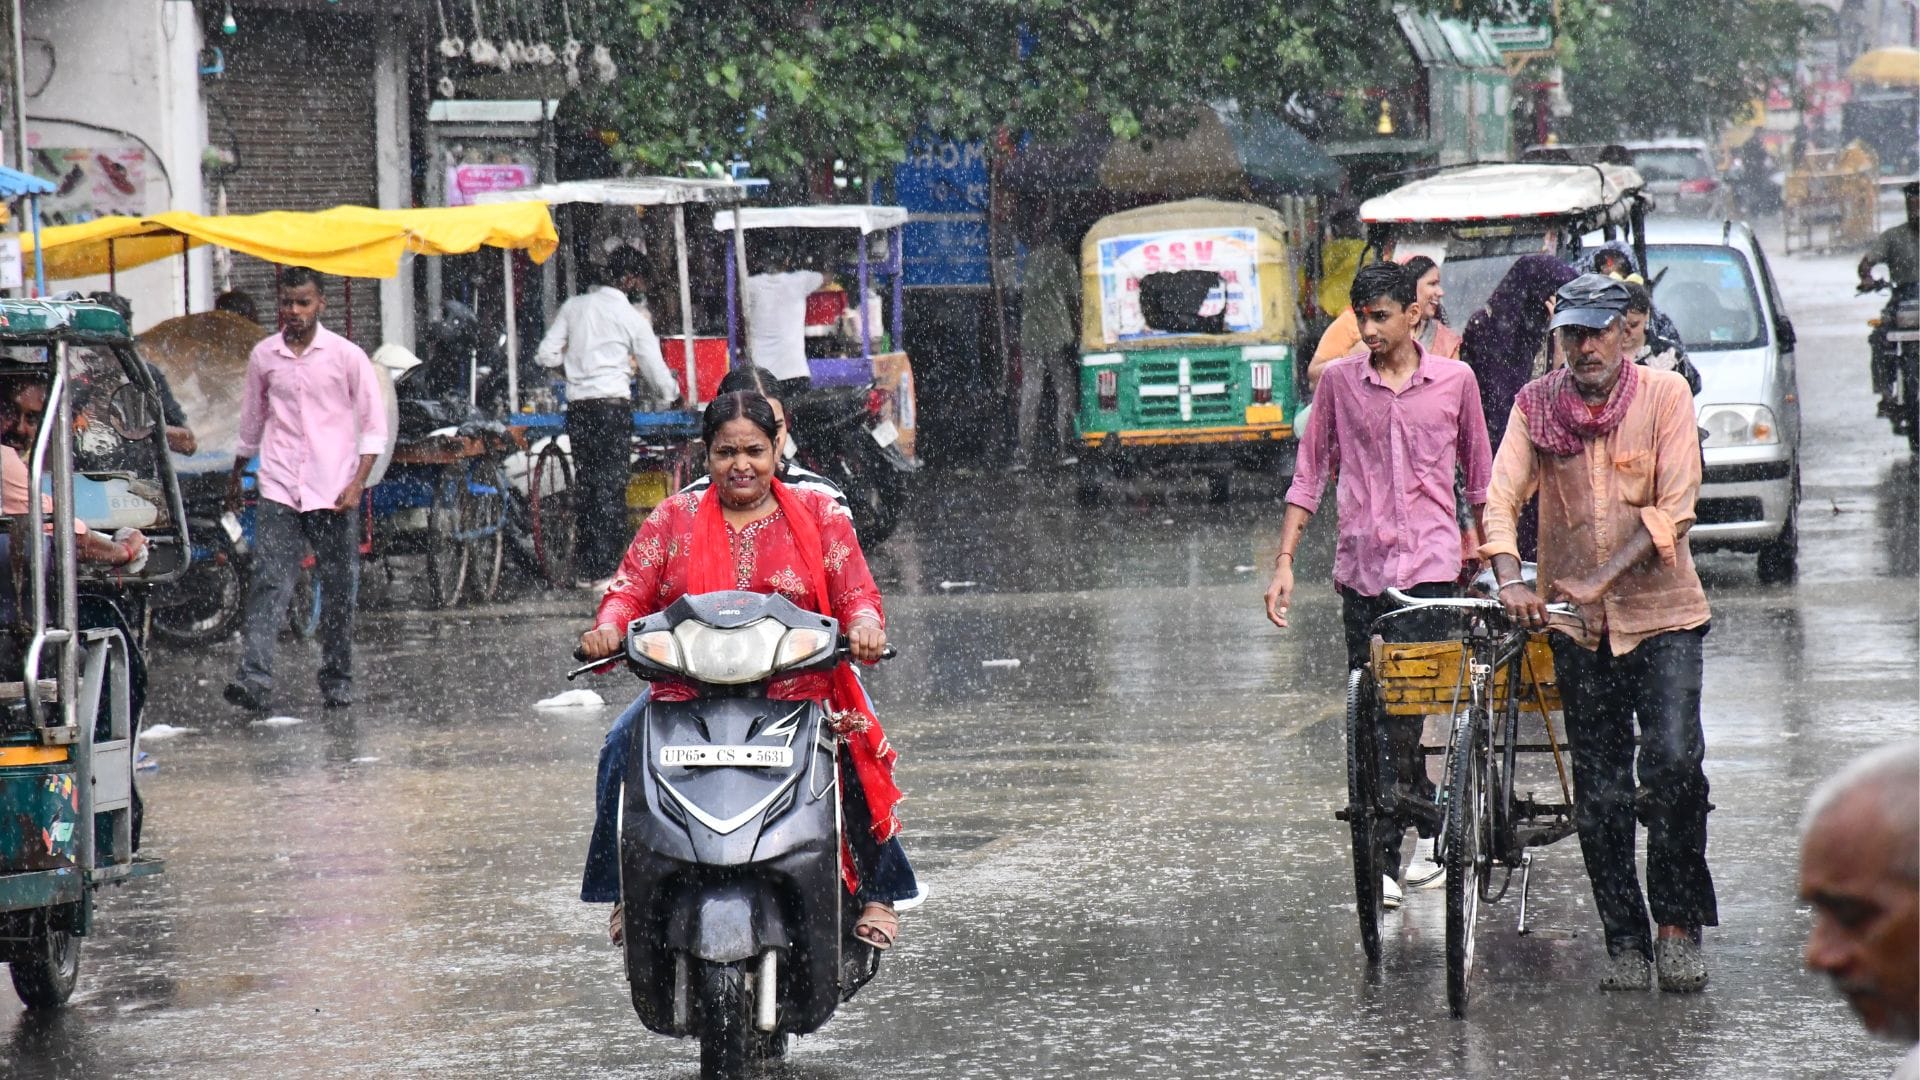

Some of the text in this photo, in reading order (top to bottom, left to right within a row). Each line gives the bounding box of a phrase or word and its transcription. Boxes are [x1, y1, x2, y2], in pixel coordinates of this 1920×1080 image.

[665, 749, 785, 763] UP65 CS 5631
